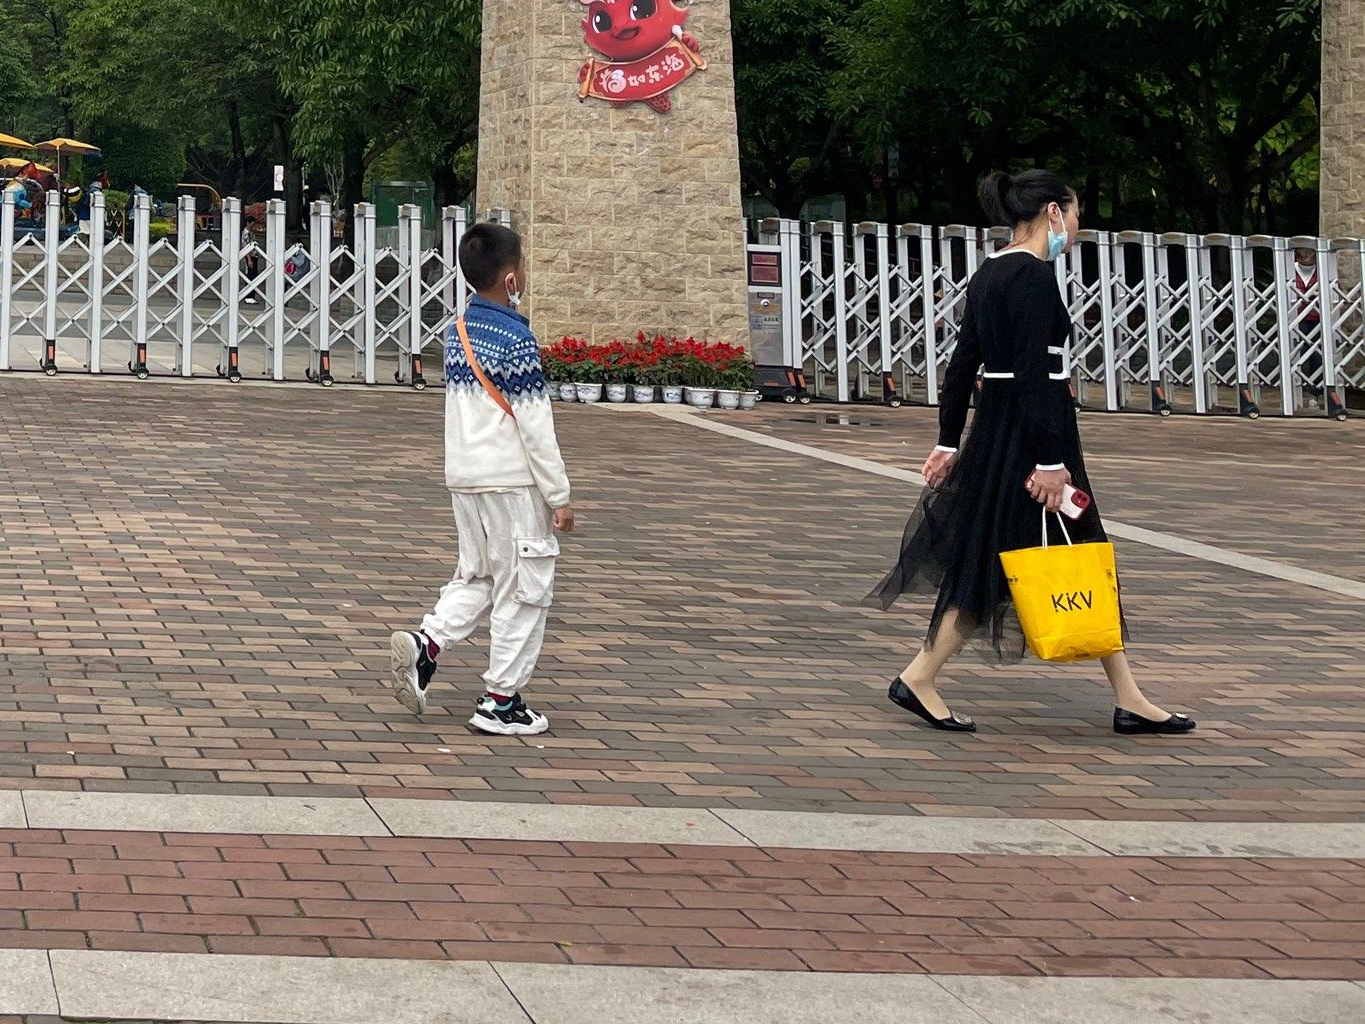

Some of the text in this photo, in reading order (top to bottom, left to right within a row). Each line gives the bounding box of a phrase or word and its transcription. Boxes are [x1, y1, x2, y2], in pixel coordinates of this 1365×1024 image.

[599, 53, 685, 94] 福如东海
[1051, 589, 1093, 613] KKV
